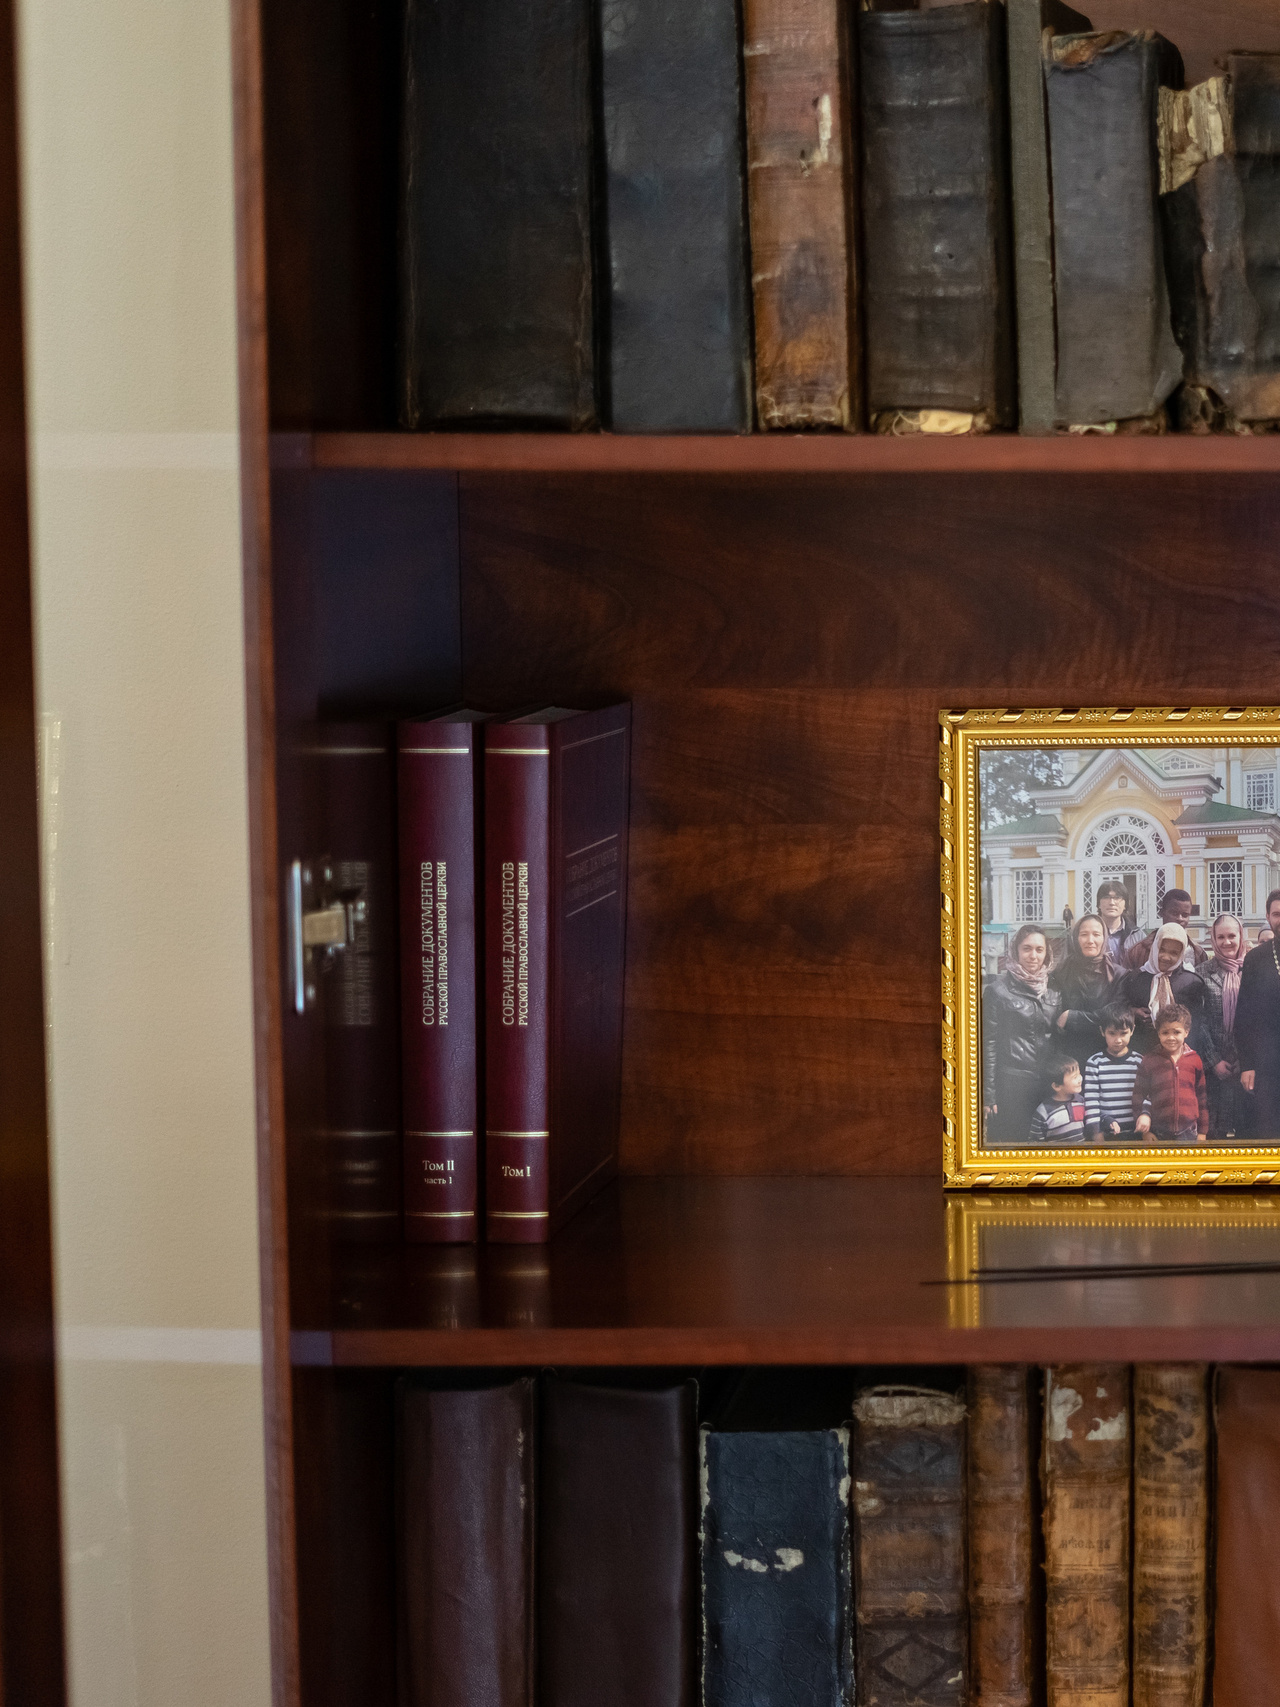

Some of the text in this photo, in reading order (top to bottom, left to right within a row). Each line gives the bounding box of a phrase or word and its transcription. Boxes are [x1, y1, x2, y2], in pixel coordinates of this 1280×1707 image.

[420, 861, 436, 1026] СОБРАНИЕ ДОКУМЕНТОВ
[436, 861, 449, 1026] РУССКОЙ ПРАВОСЛАВНОЙ ЦЕРКВИ
[501, 861, 516, 1026] СОБРАНИЕ ДОКУМЕНТОВ
[517, 861, 529, 1026] РУССКОЙ ПРАВОСЛАВНОЙ ЦЕРКВИ
[422, 1160, 455, 1171] Том II
[423, 1177, 446, 1185] часть
[502, 1165, 531, 1177] Том I
